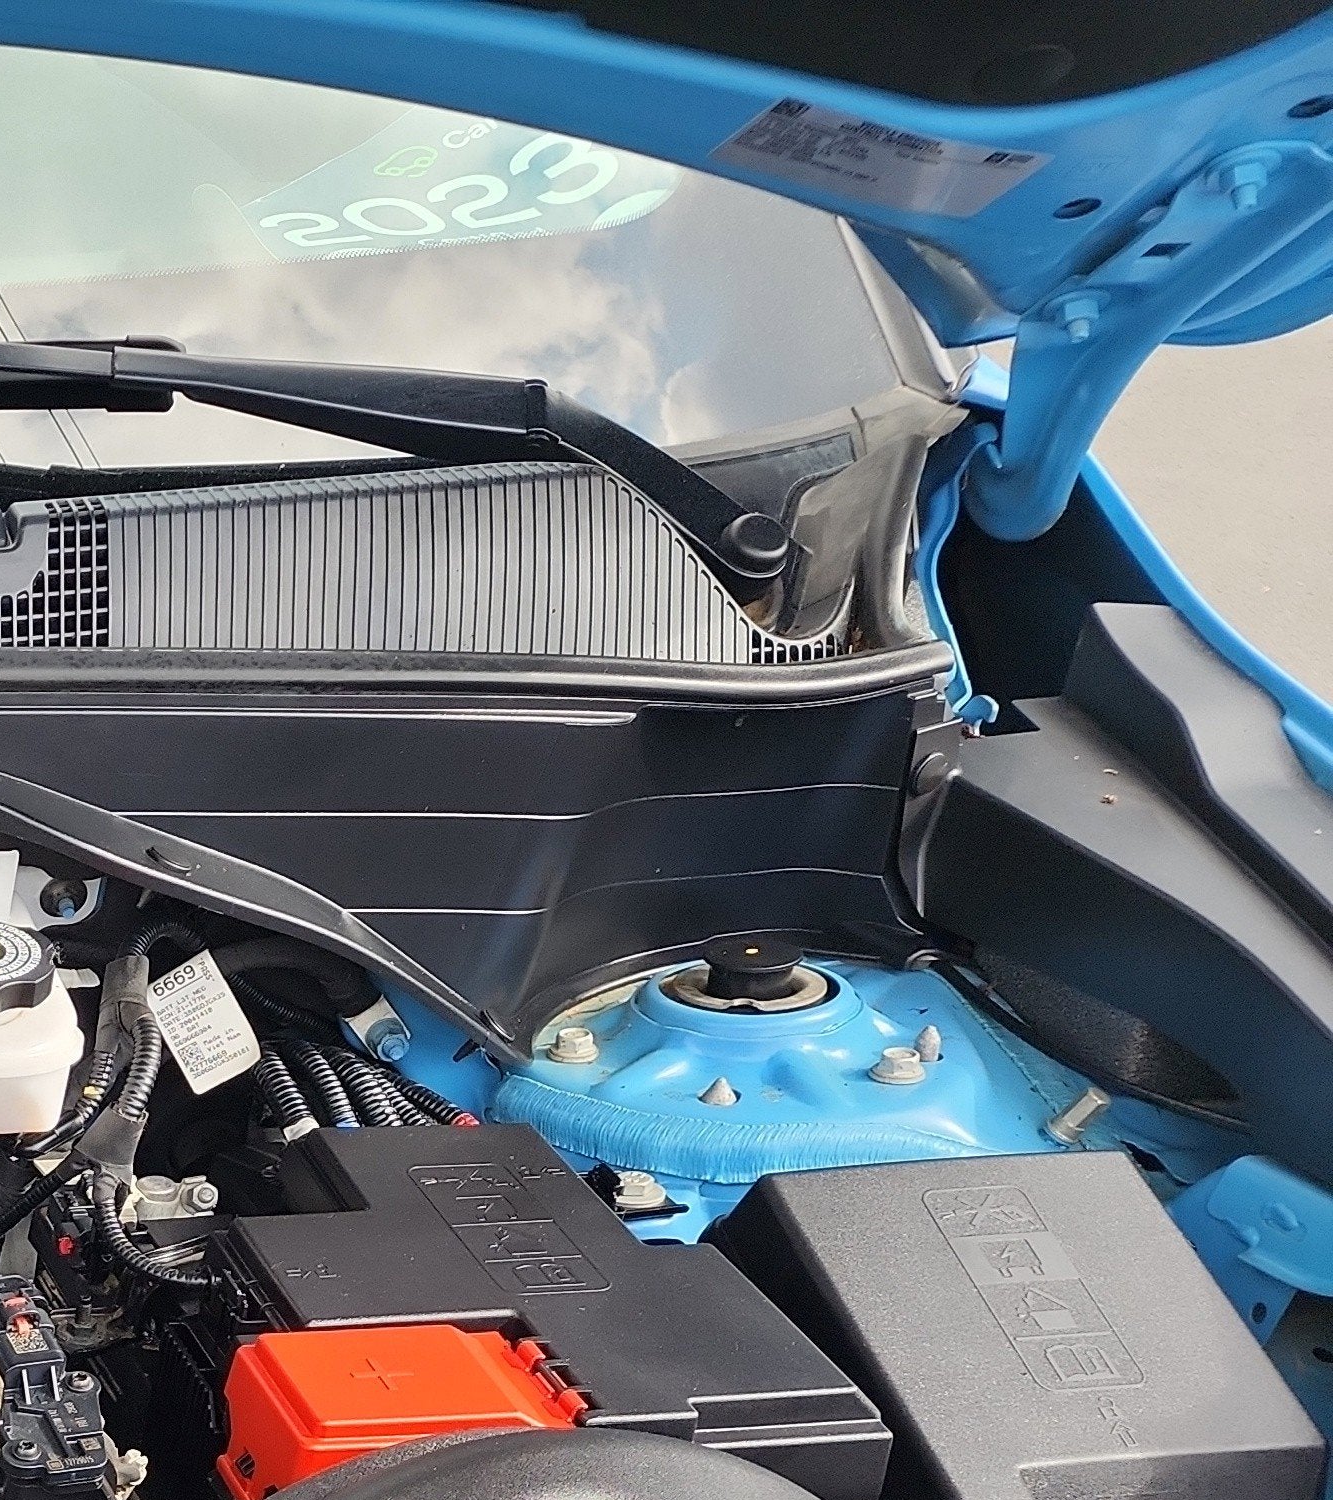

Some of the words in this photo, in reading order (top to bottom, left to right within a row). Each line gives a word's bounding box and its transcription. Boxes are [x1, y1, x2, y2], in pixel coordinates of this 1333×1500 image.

[152, 964, 197, 997] 6669
[202, 1034, 222, 1046] Made
[206, 1040, 225, 1053] Viet
